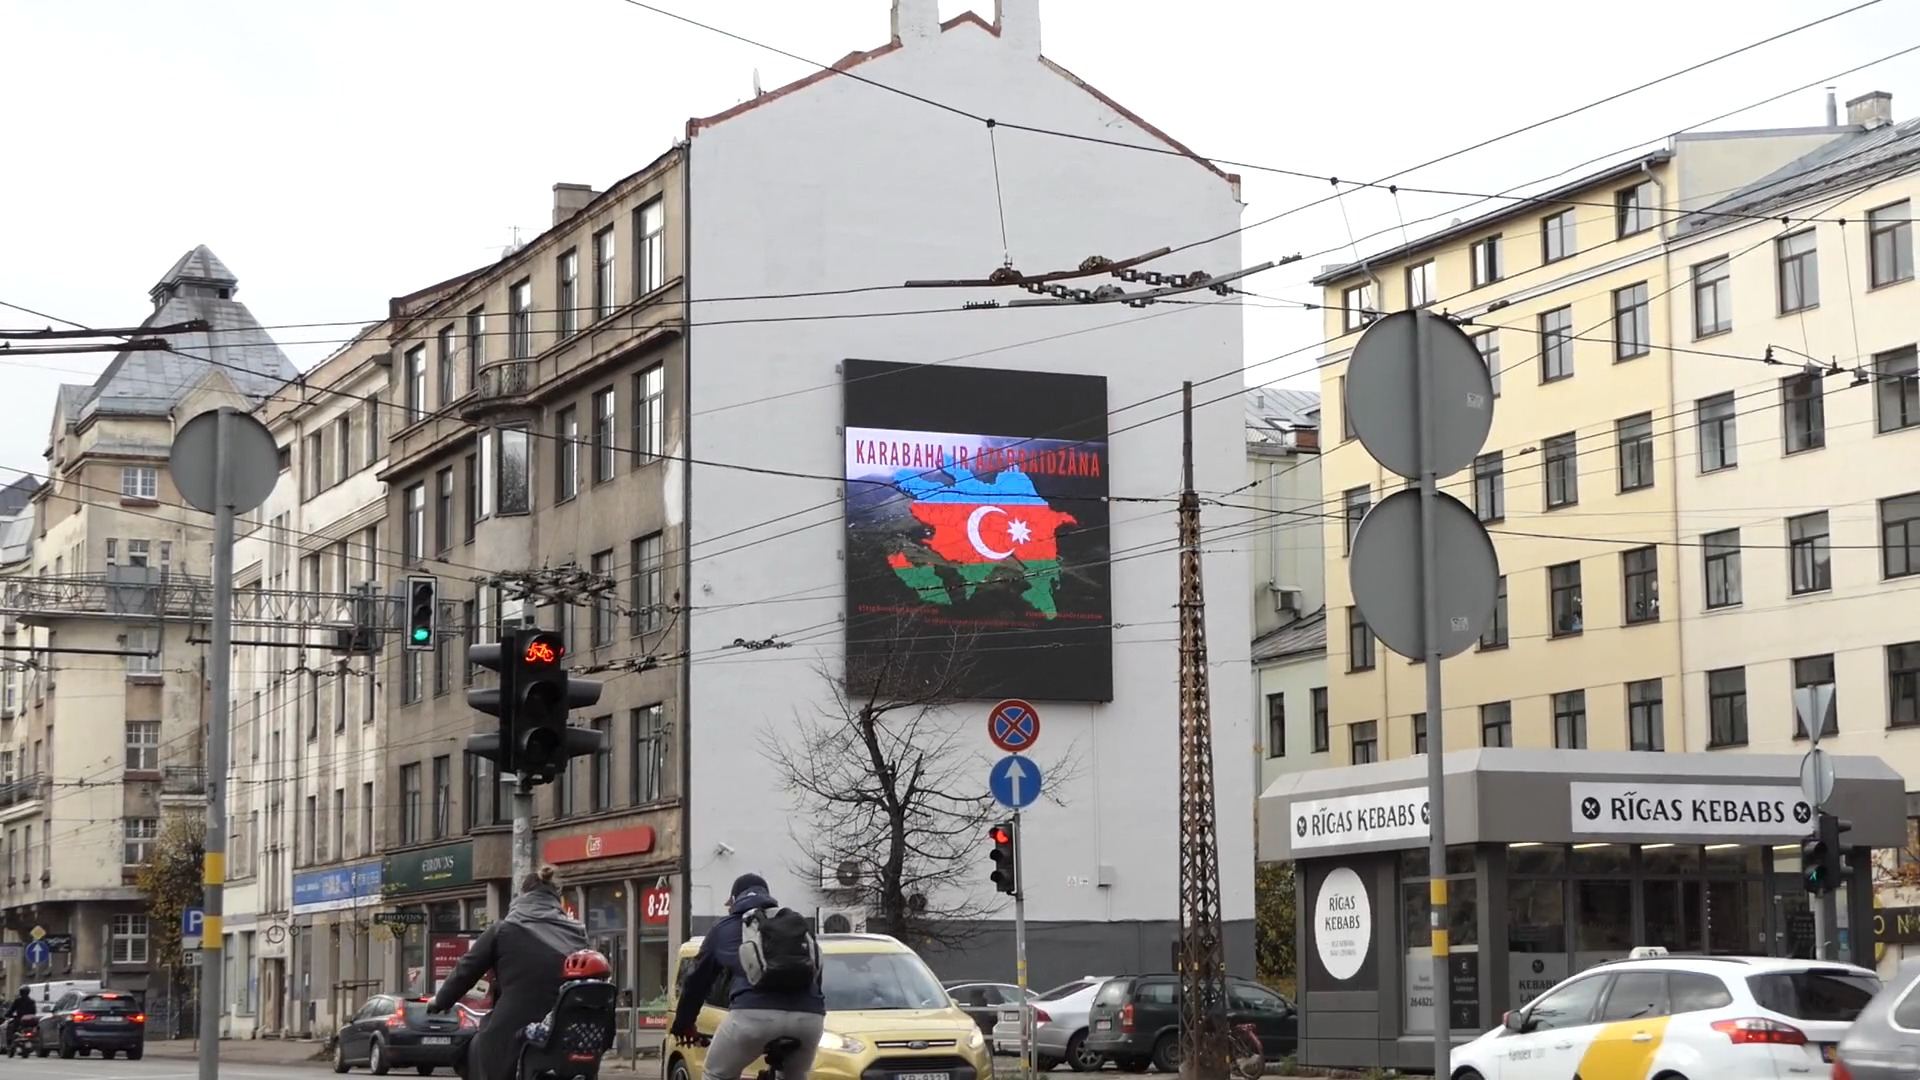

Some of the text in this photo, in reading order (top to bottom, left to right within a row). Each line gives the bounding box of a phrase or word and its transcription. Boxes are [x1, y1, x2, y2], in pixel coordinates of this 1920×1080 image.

[856, 440, 944, 468] KARABAHA
[952, 446, 968, 469] IR
[1311, 802, 1416, 837] RĪGAS KEBABS
[1611, 791, 1786, 824] RĪGAS KEBABS
[1329, 892, 1355, 912] RĪGAS
[189, 910, 204, 932] P
[1325, 915, 1361, 931] KEBABS
